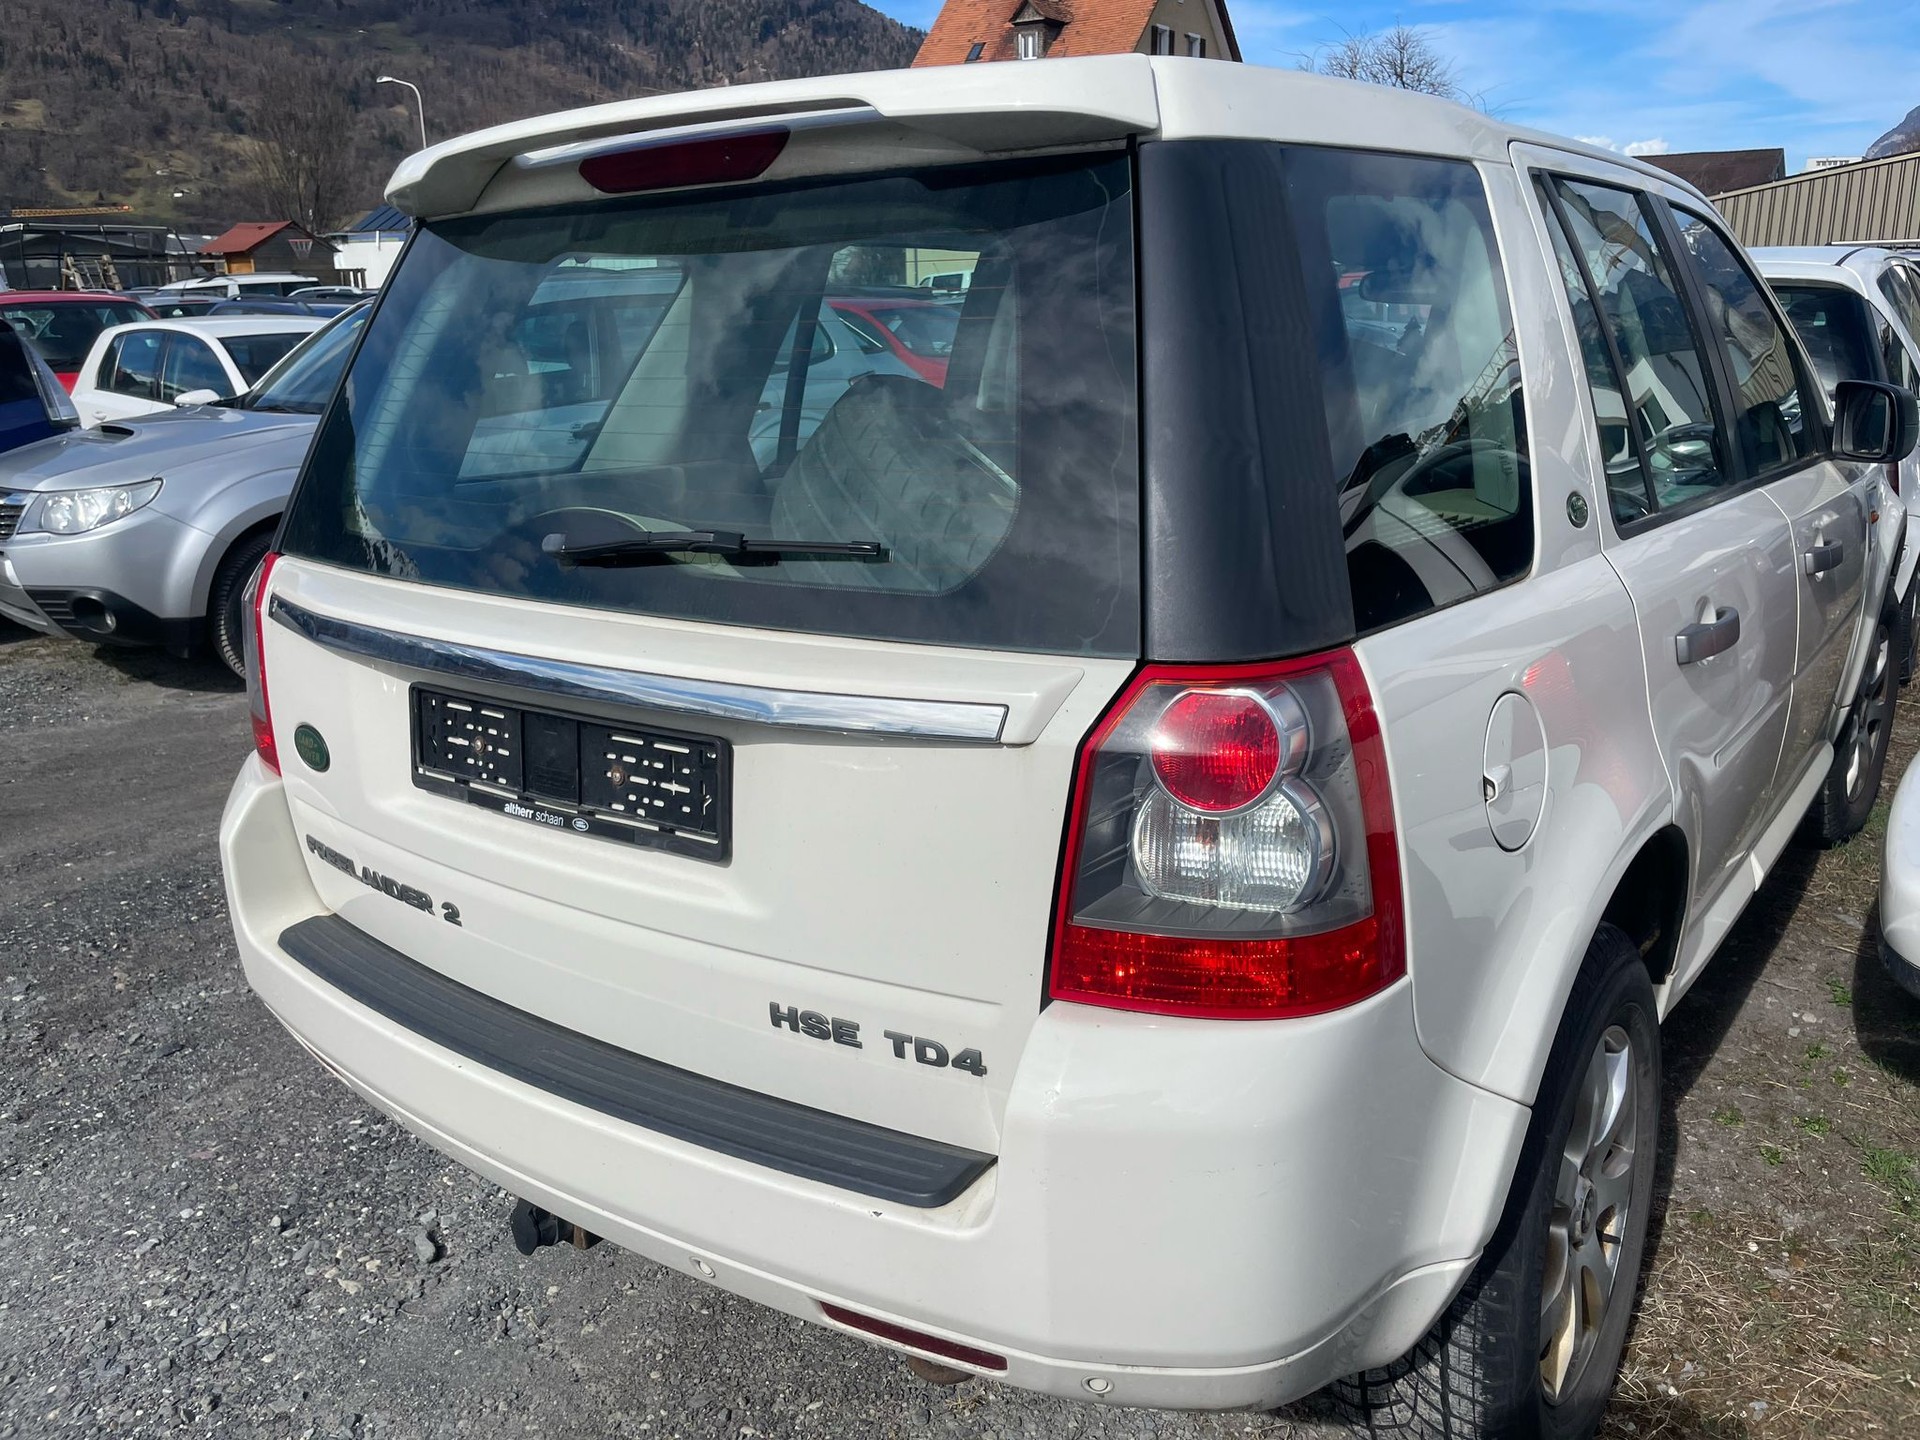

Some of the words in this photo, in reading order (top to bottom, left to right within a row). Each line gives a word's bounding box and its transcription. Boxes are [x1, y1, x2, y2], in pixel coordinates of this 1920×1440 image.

[504, 802, 534, 819] altherr
[535, 810, 564, 827] schaan
[306, 834, 435, 916] FREELANDER
[441, 902, 463, 927] 2
[769, 1001, 863, 1050] HSE
[883, 1029, 988, 1078] TD4
